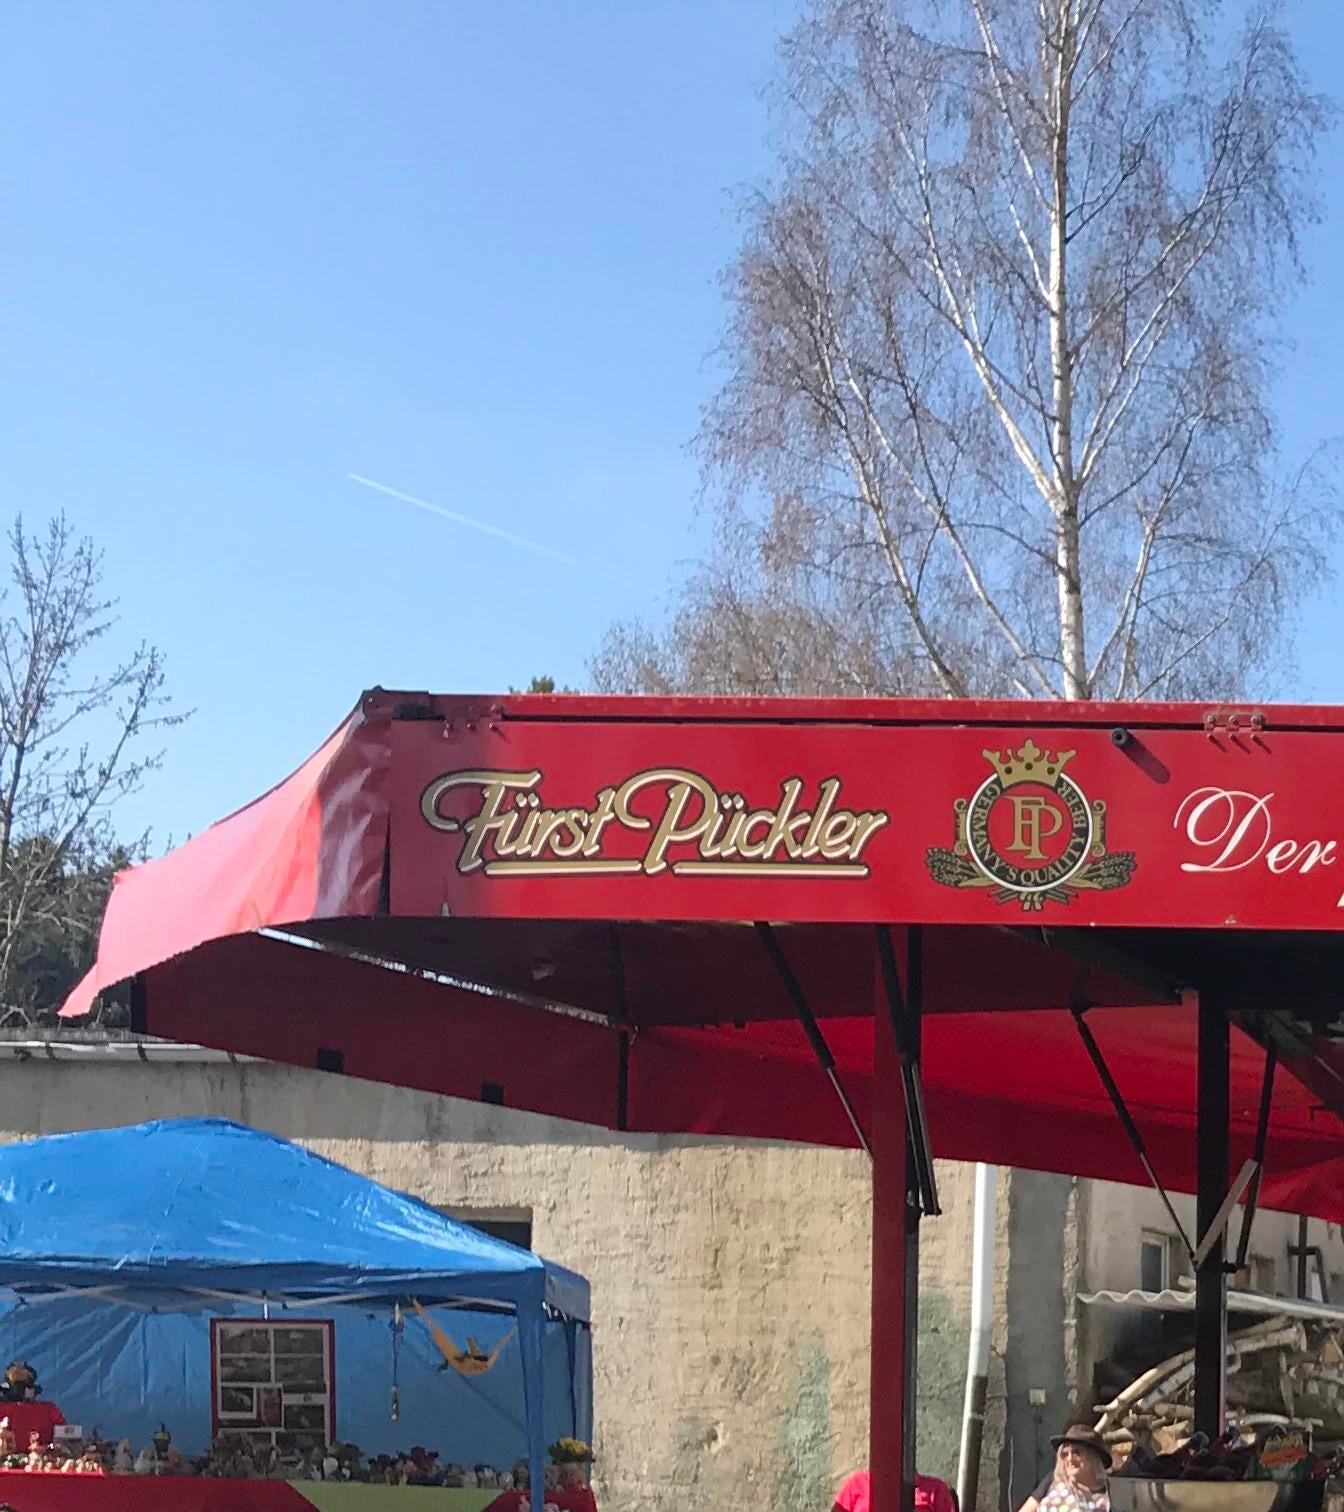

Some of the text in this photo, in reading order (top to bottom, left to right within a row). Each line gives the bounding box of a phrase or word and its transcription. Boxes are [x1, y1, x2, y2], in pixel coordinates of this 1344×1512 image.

[421, 766, 889, 877] Fürst Pückler
[1020, 832, 1085, 886] QUALITY
[1056, 781, 1086, 828] BEER
[1174, 786, 1336, 874] Der
